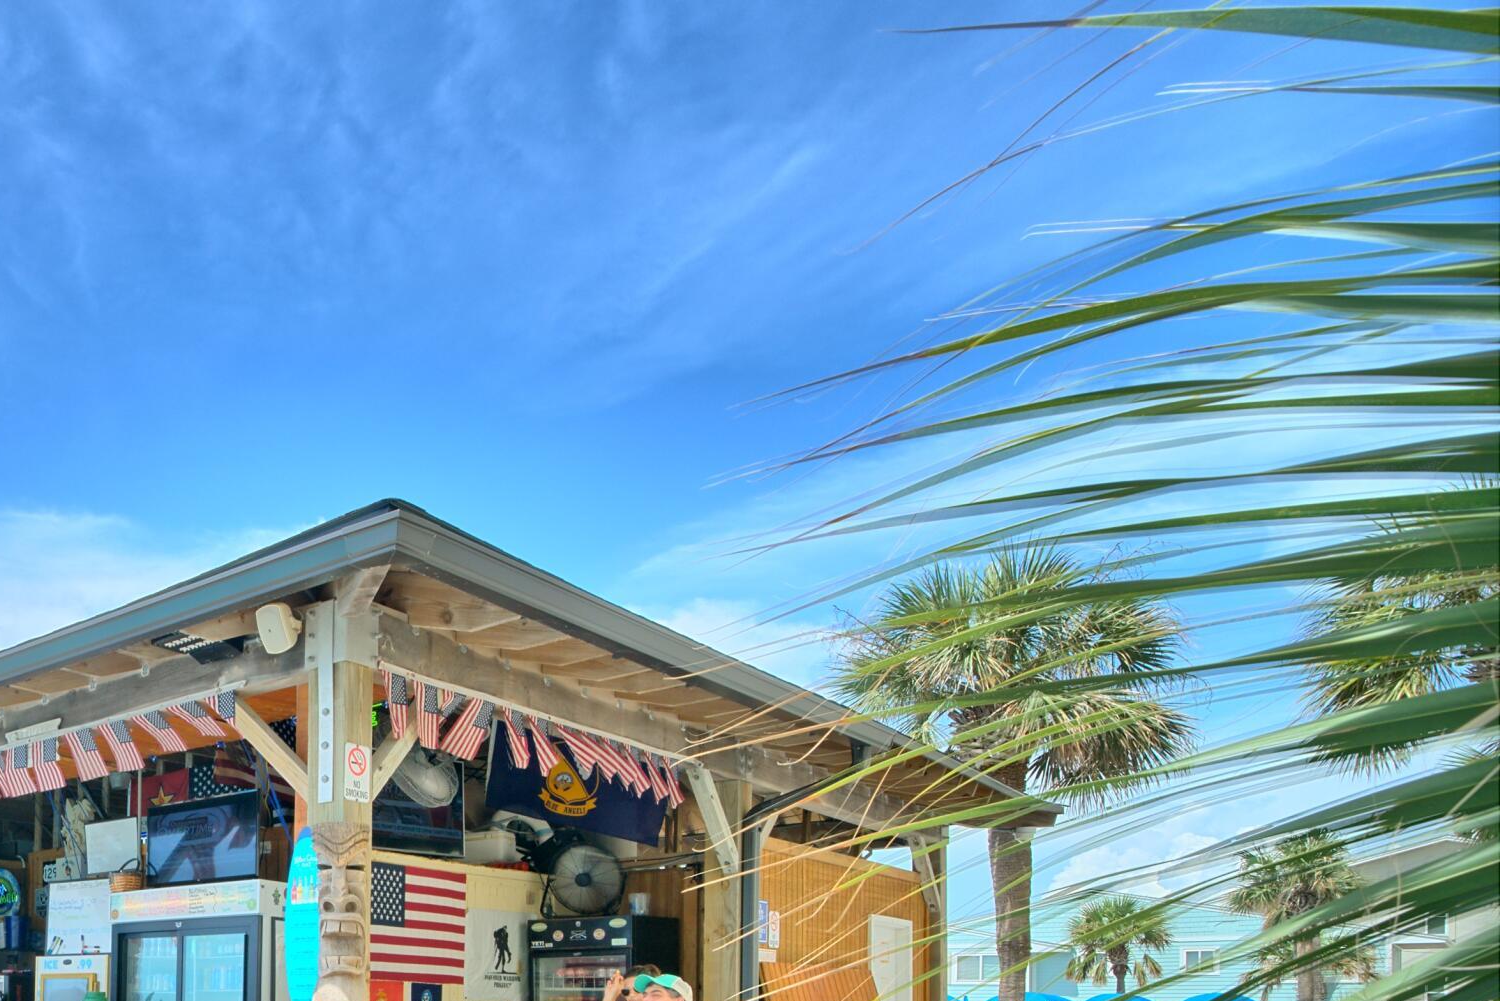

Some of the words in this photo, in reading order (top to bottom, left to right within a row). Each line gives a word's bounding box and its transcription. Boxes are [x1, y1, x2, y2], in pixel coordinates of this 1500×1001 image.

[353, 780, 361, 789] NO
[345, 787, 369, 800] SMOKING
[44, 960, 58, 969] ICE
